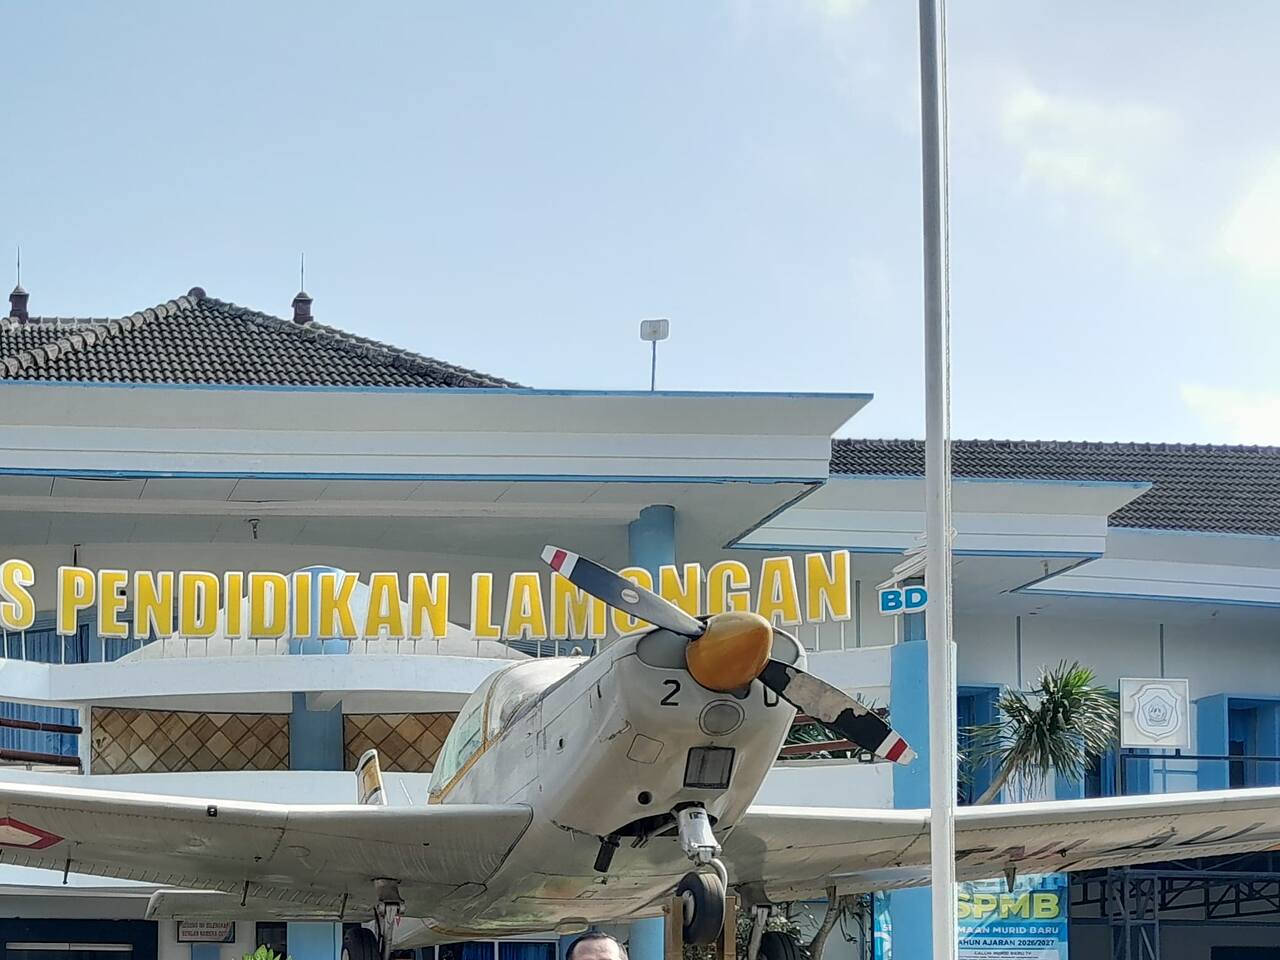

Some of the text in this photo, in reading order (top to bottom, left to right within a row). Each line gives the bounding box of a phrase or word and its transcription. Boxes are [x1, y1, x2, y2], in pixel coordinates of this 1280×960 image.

[57, 566, 450, 641] PENDIDIKAN
[471, 549, 852, 641] LAMONGAN
[660, 679, 681, 706] 2
[958, 893, 1060, 919] SPMB
[992, 926, 1027, 934] MURID
[1029, 926, 1059, 934] BARU
